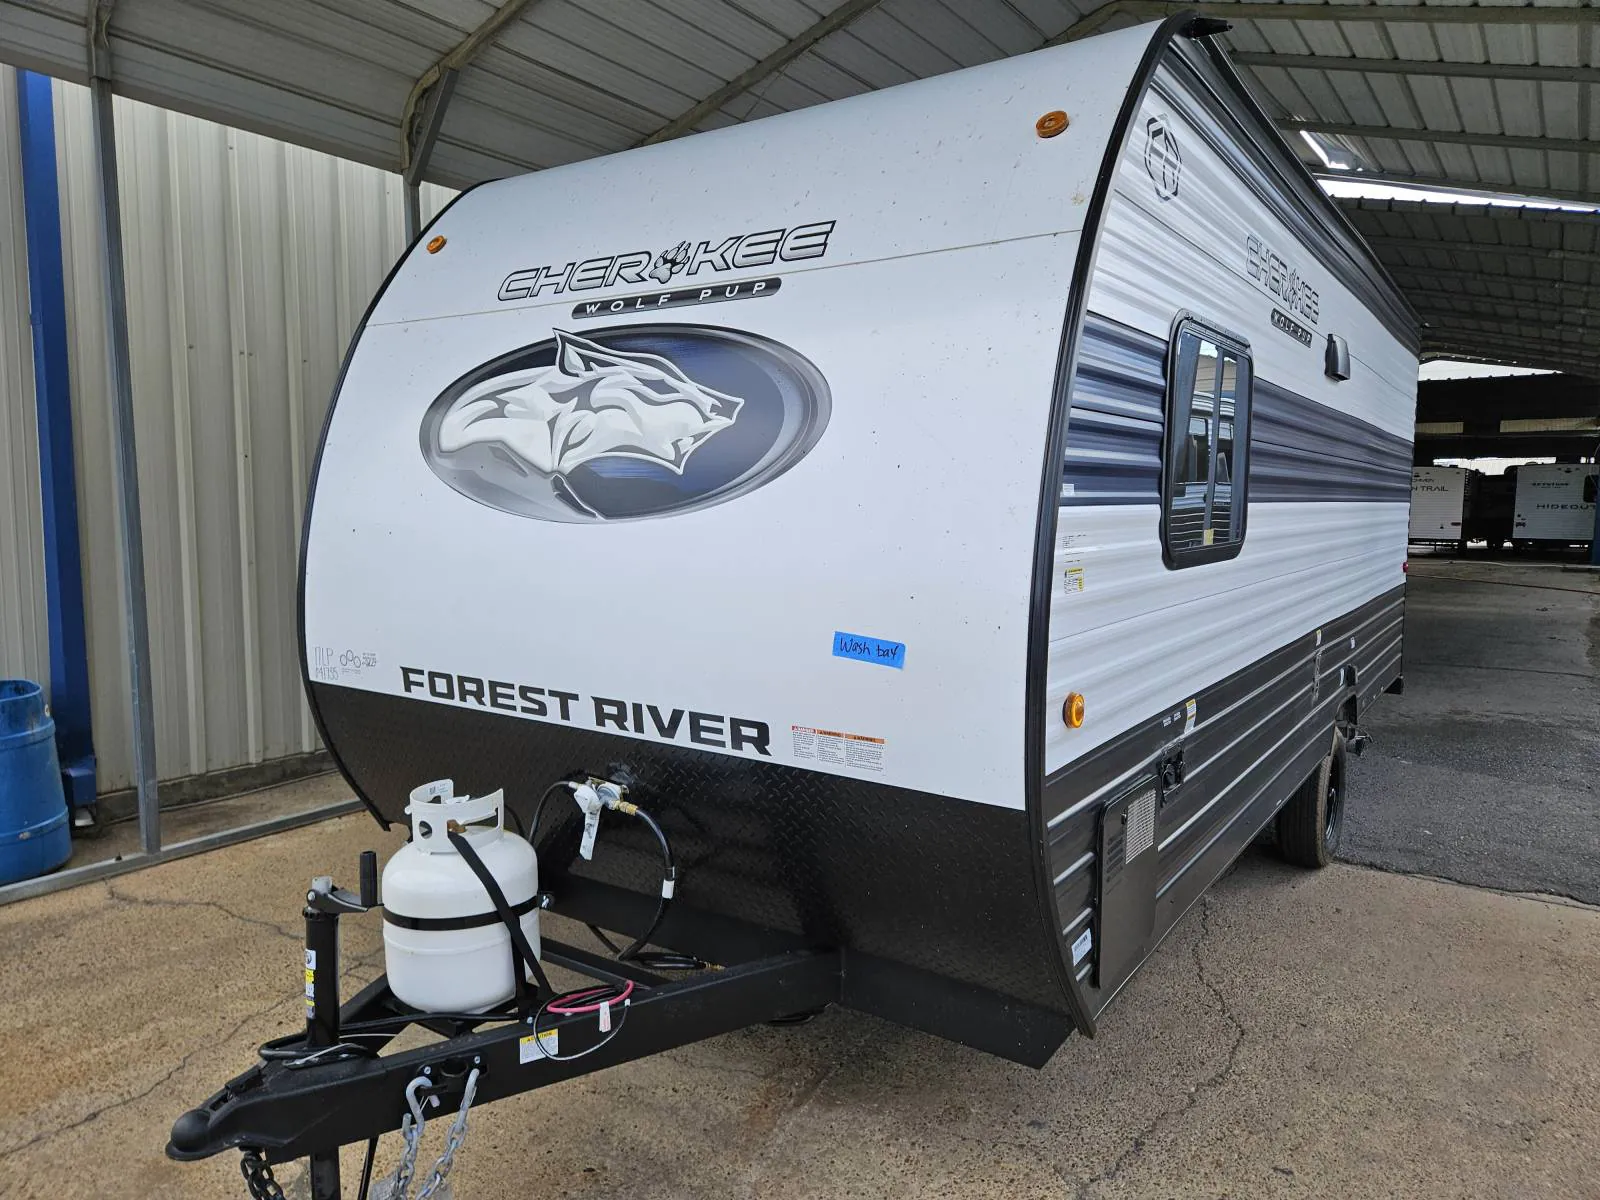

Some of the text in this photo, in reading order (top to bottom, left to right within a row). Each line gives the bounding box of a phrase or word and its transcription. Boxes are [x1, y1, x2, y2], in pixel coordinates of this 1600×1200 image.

[585, 282, 767, 316] WOLF PUP
[1273, 311, 1295, 333] WOLF
[840, 637, 900, 660] Wash bay
[400, 665, 579, 721] FOREST
[590, 695, 772, 757] RIVER
